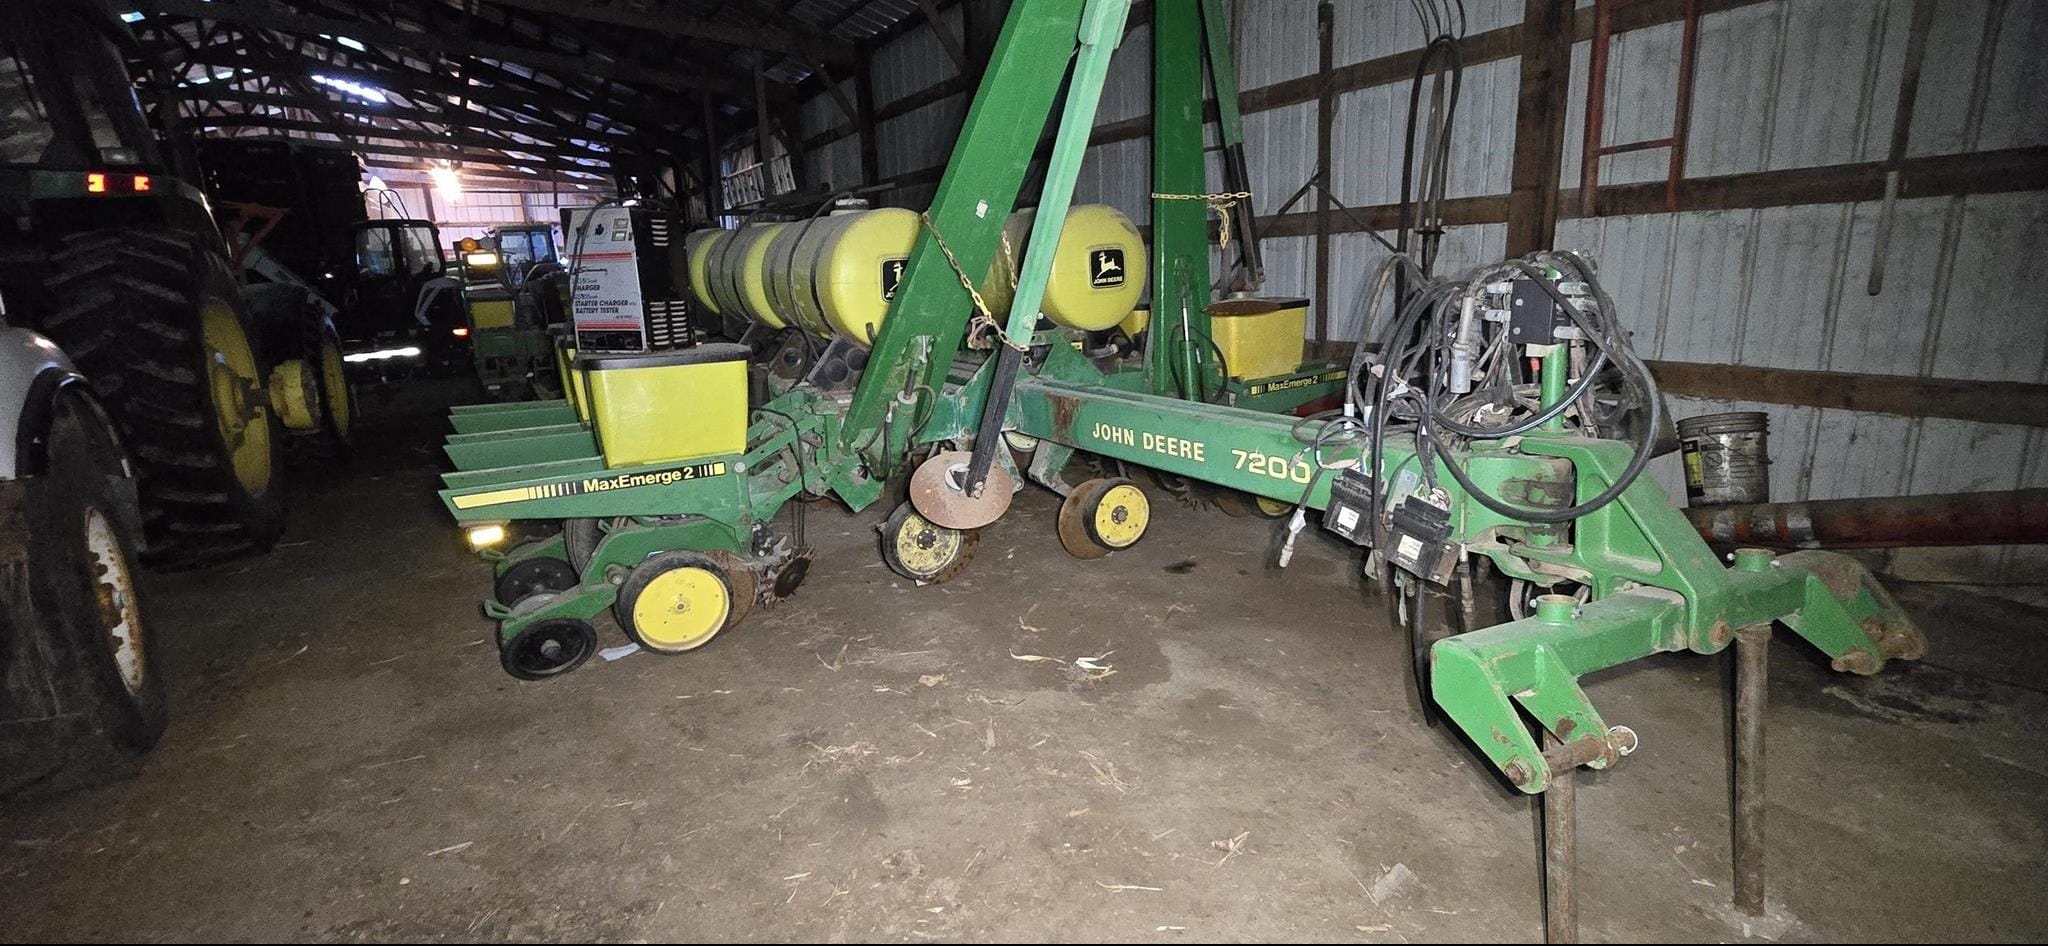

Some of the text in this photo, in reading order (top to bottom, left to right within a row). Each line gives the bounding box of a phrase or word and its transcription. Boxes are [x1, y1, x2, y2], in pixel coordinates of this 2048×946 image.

[1268, 376, 1319, 392] MaxEmerge 2
[1092, 422, 1311, 484] JOHN DEERE 7200
[583, 467, 694, 493] MaxEmerge 2
